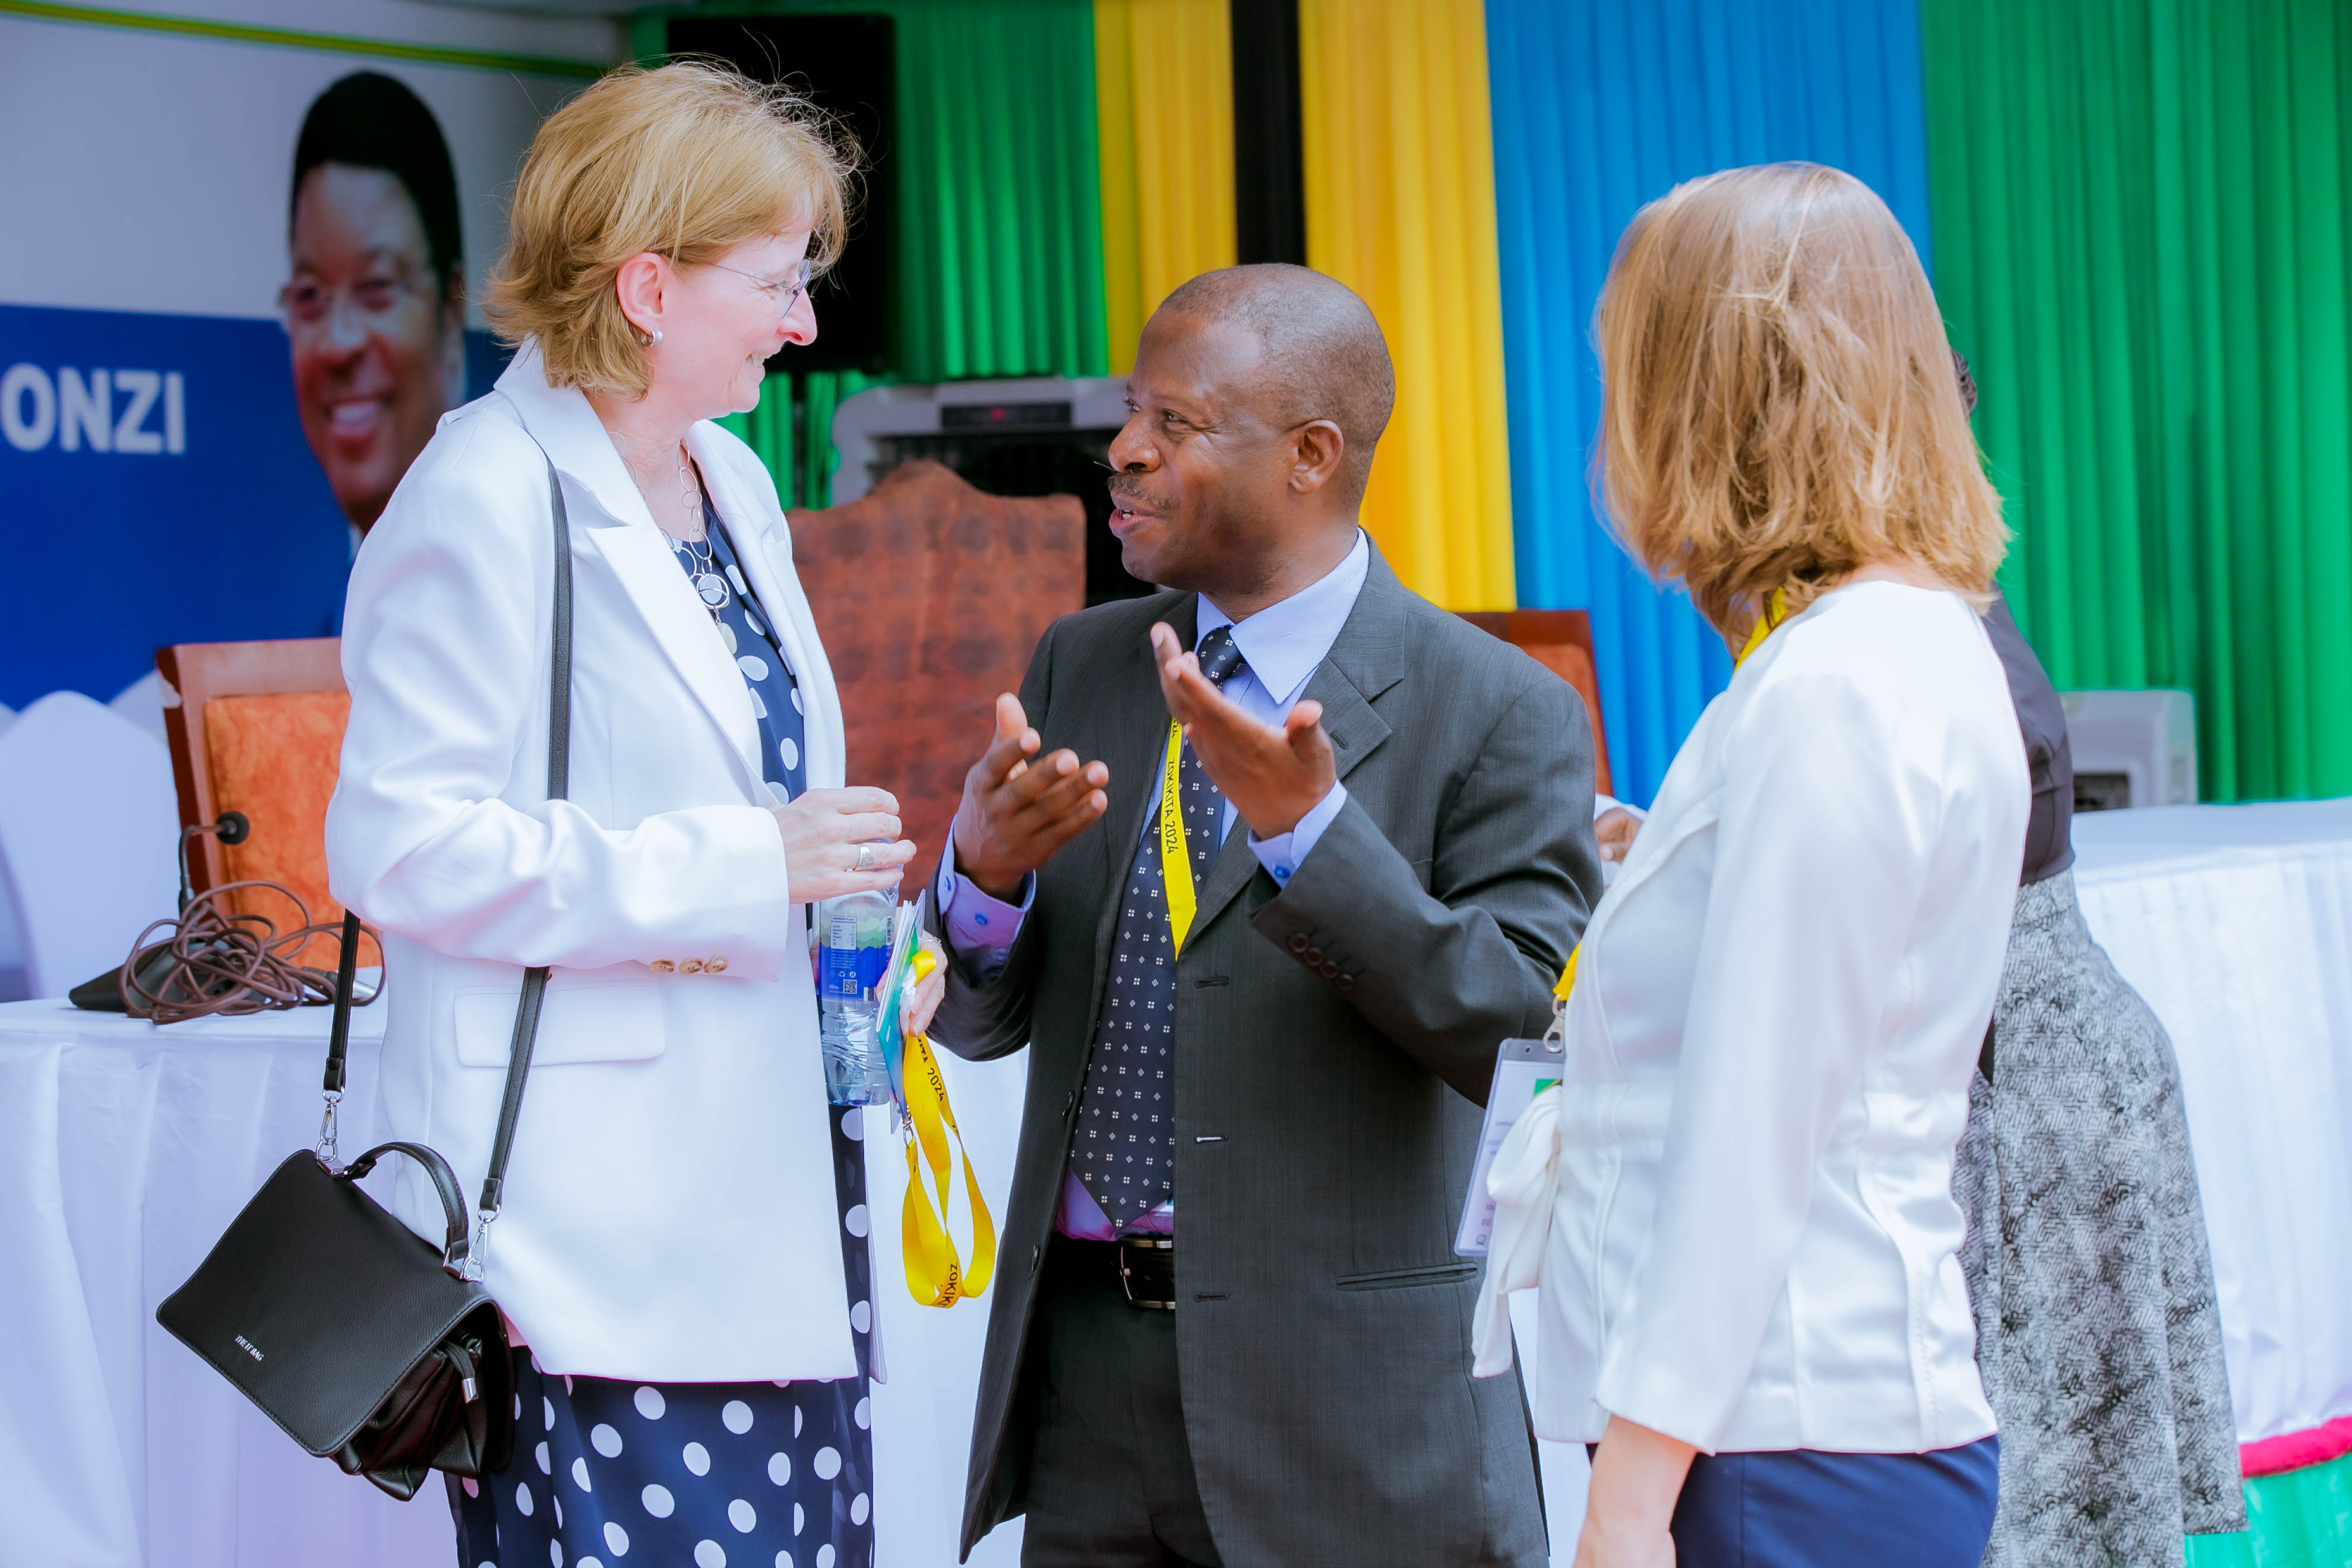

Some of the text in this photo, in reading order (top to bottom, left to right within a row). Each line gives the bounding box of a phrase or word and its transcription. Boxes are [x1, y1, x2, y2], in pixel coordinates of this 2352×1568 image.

[0, 362, 185, 455] ONZI
[1165, 755, 1179, 854] ZOKIKITA 2024
[927, 1067, 945, 1102] 2024
[937, 1262, 957, 1307] ZOKIKI
